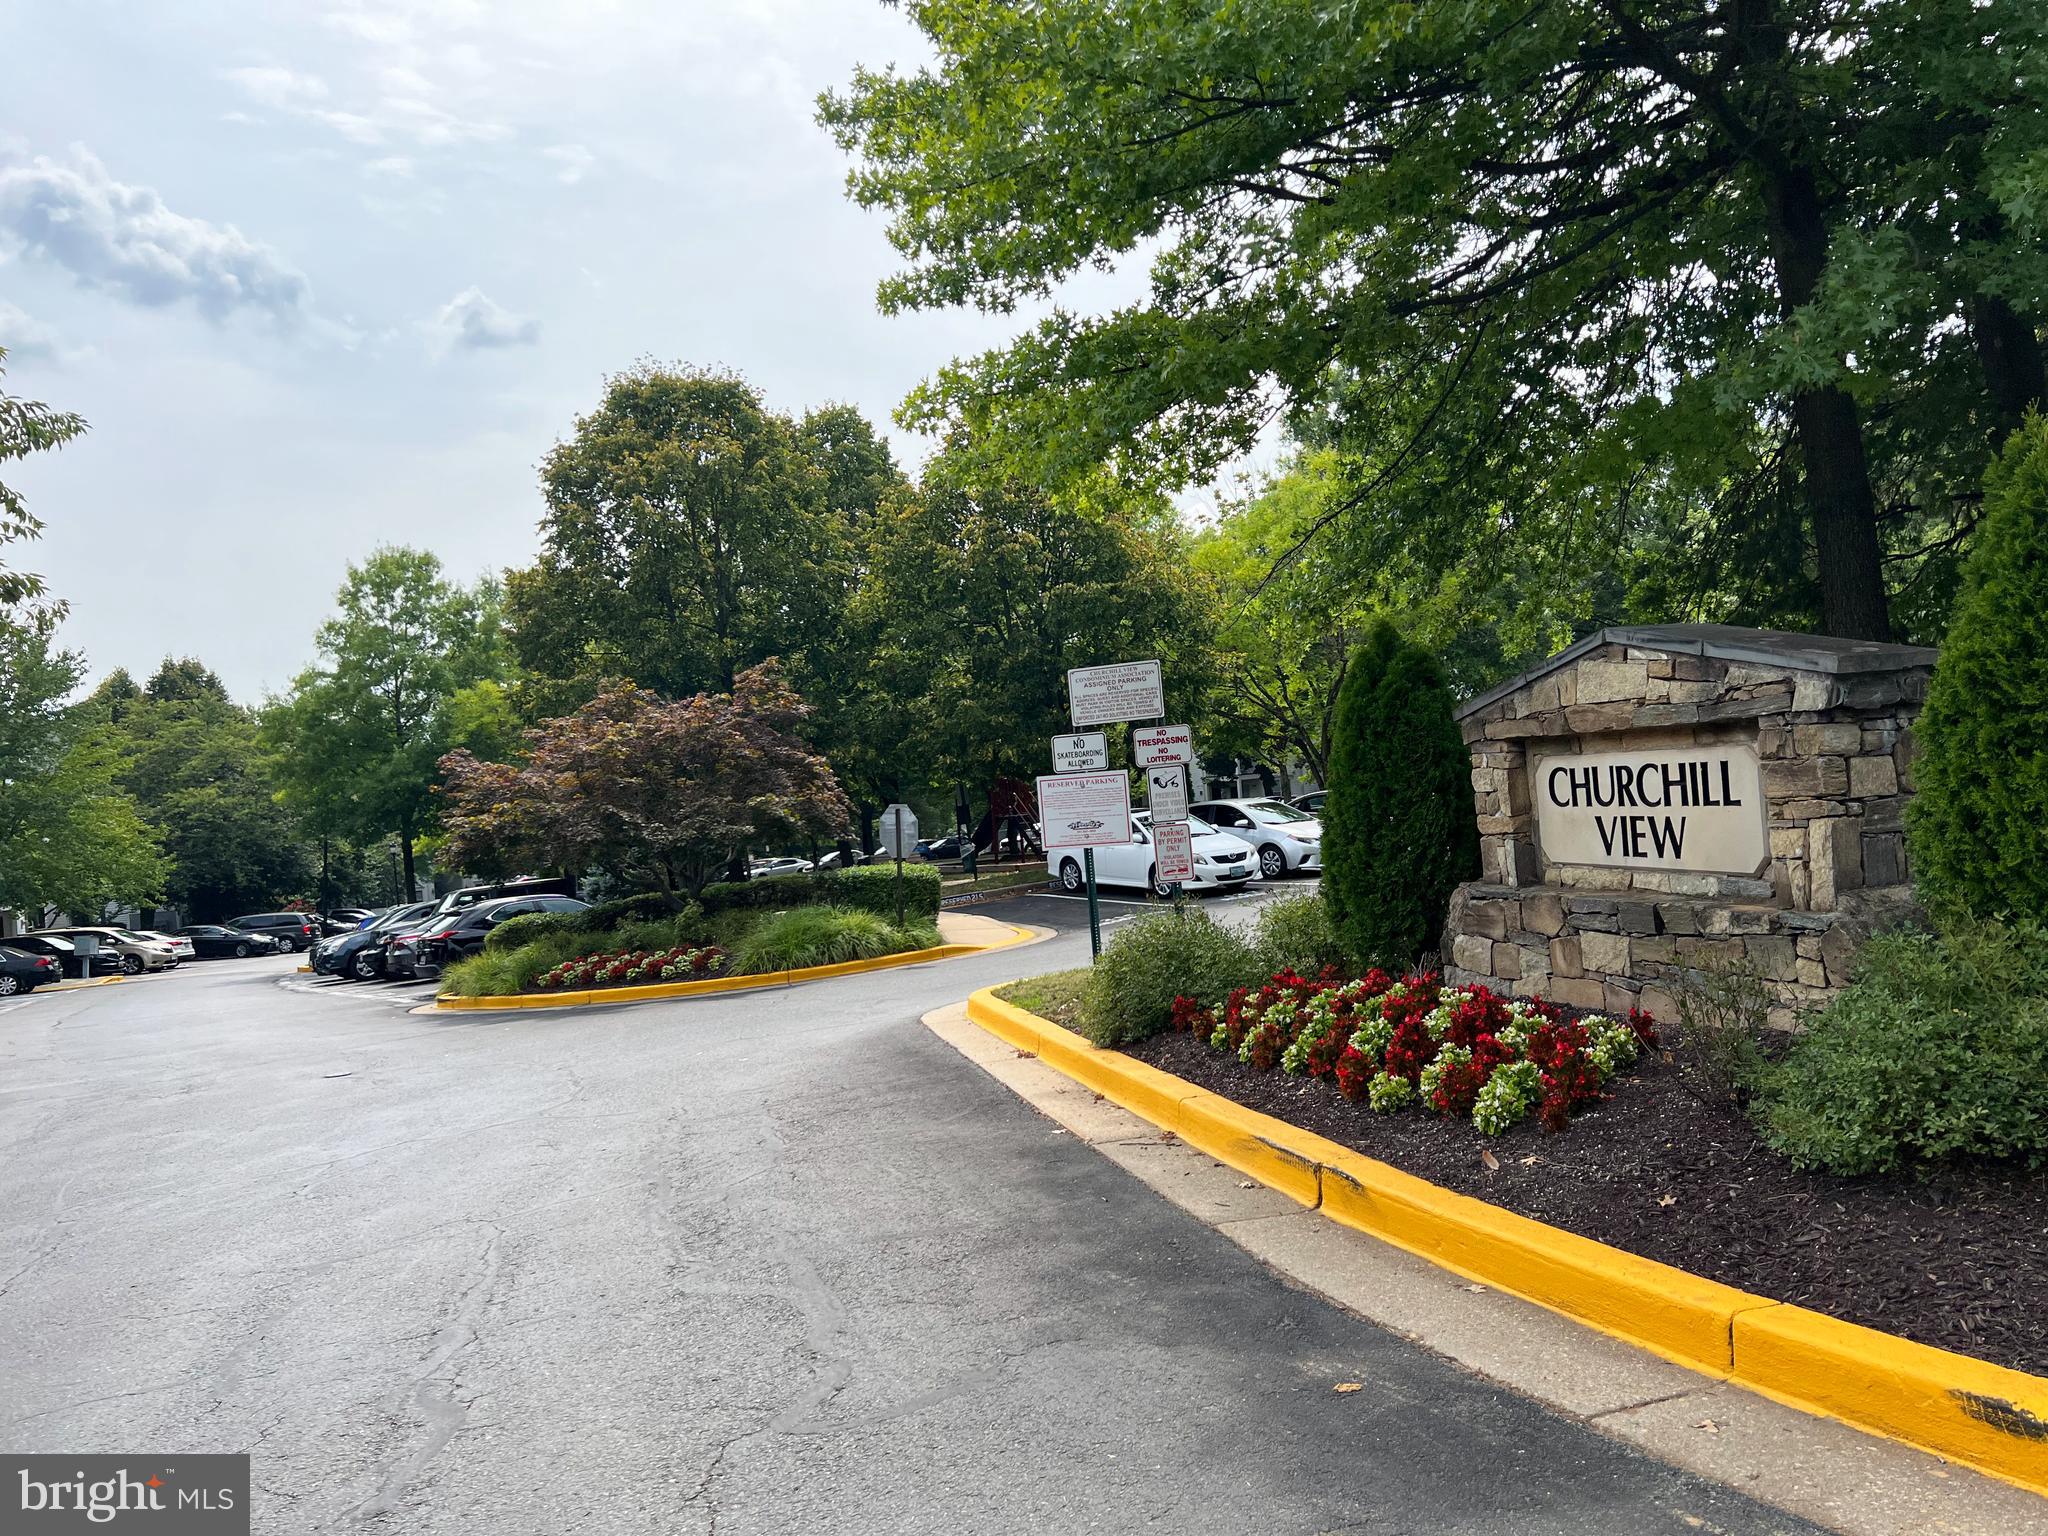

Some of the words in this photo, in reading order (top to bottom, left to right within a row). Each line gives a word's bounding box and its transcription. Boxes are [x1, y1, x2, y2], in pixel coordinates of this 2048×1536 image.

[1075, 674, 1117, 683] CONDOMINIUM
[1117, 669, 1155, 679] ASSOCIATION
[1084, 679, 1117, 688] ASSIGNED
[1118, 676, 1147, 684] PARKING
[1073, 739, 1085, 749] NO
[1137, 735, 1188, 747] TRESPASSING
[1057, 749, 1103, 760] SKATEBOARDING
[1147, 754, 1181, 763] LOITERING
[1047, 780, 1084, 788] RESERVED
[1086, 777, 1118, 786] PARKING
[1548, 760, 1742, 808] CHURCHILL
[1160, 830, 1184, 838] PARKING
[1594, 815, 1687, 860] VIEW
[1166, 837, 1187, 845] PERMIT
